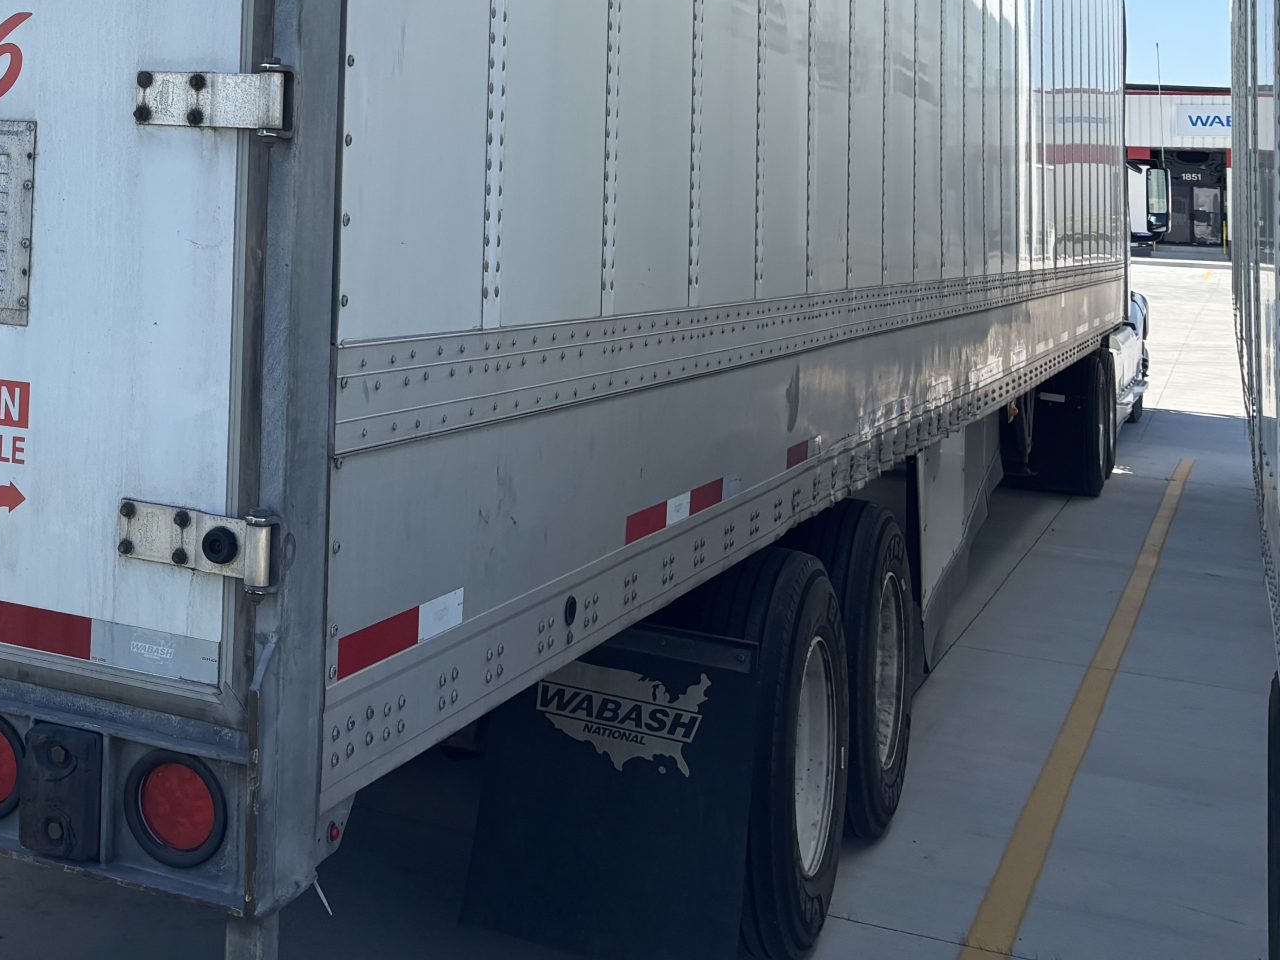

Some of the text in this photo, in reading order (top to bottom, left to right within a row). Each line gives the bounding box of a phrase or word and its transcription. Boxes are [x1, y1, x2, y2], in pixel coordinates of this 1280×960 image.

[1181, 173, 1202, 181] 1851
[130, 641, 175, 659] WABASH
[539, 683, 699, 739] WABASH
[582, 724, 647, 746] NATIONAL
